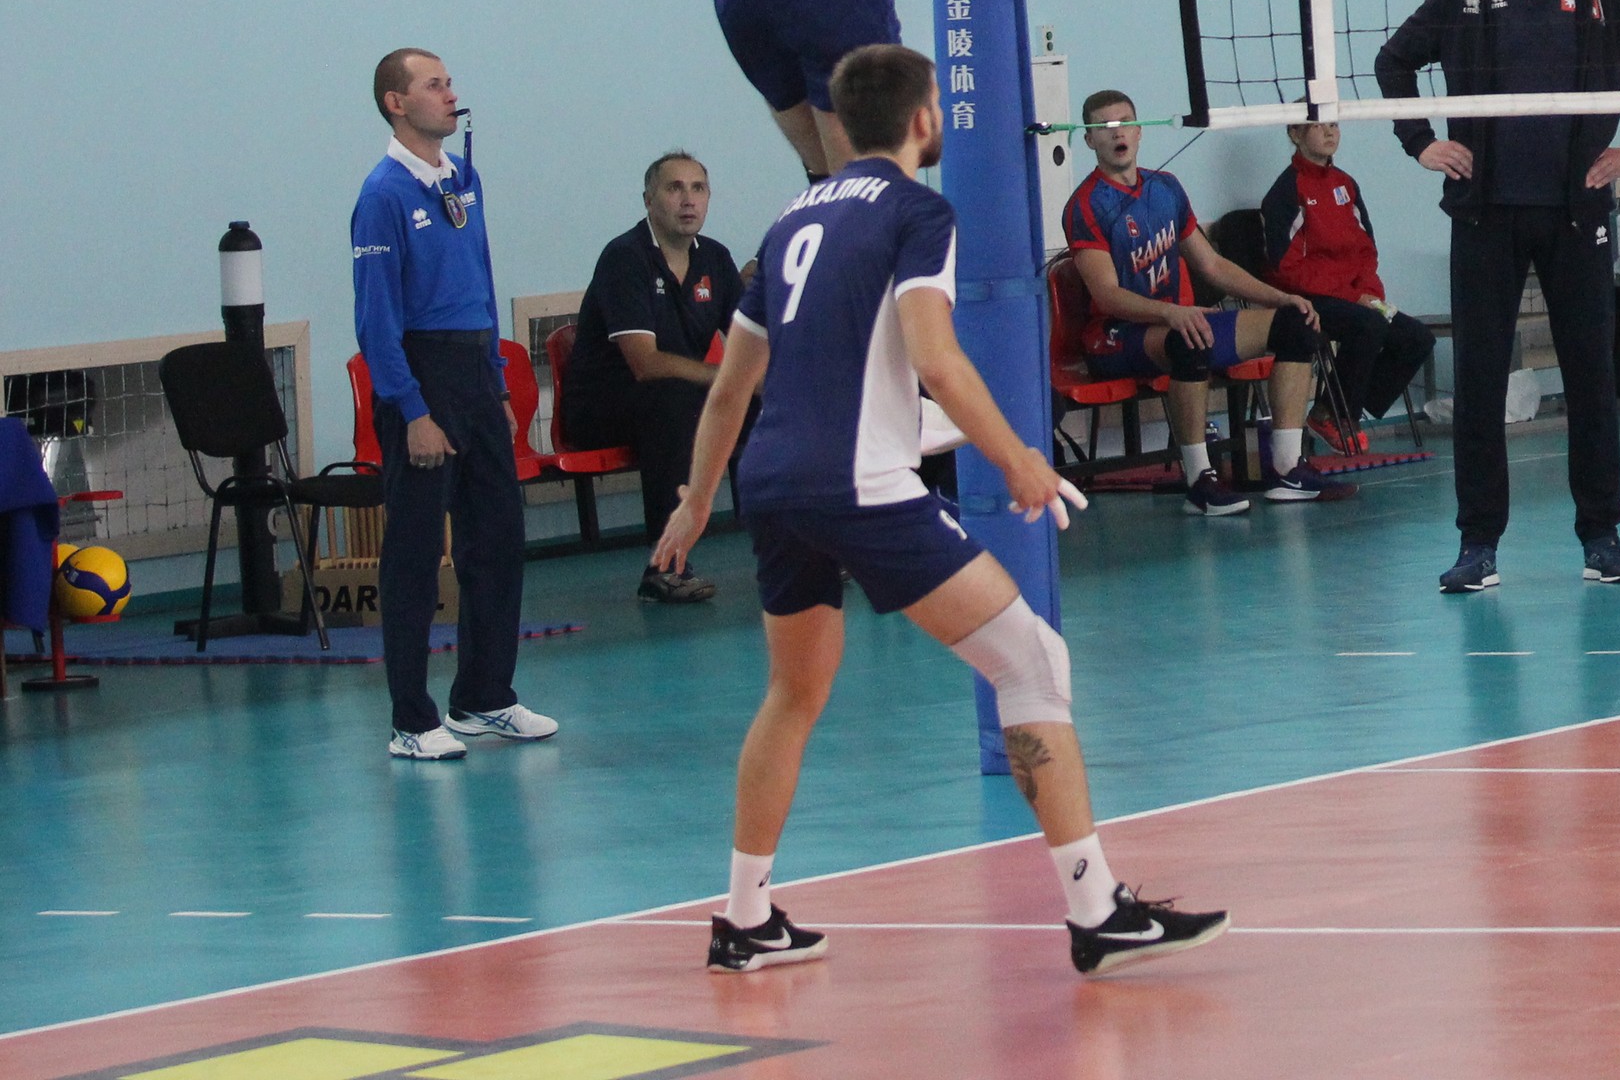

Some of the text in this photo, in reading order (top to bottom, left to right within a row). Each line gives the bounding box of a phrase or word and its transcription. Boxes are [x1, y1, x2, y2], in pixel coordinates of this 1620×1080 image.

[782, 223, 824, 324] 9
[1131, 220, 1176, 274] КАМА
[1147, 255, 1171, 296] 14
